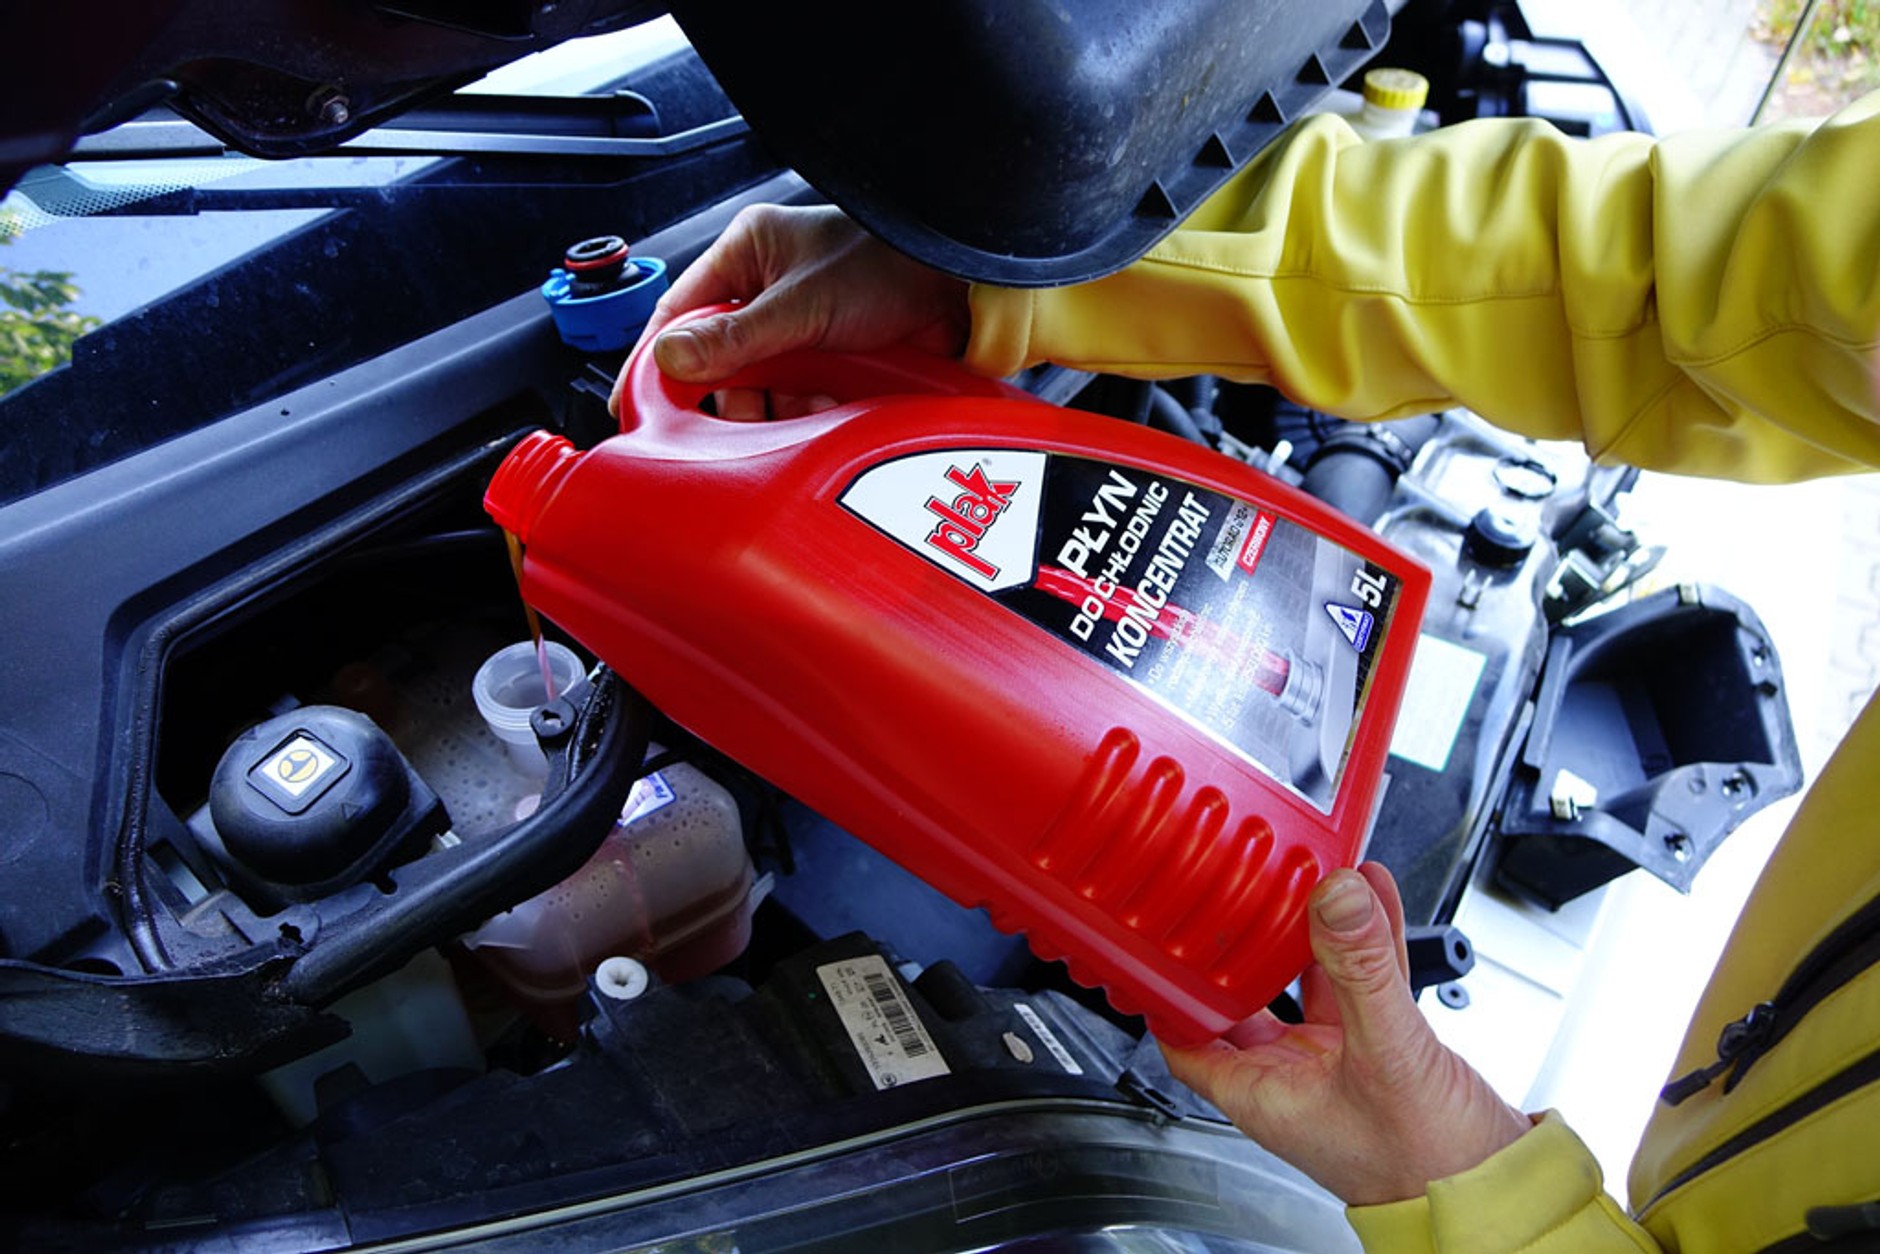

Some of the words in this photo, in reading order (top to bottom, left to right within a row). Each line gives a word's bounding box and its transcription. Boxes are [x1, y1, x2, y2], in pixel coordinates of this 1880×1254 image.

[924, 462, 1021, 581] plak
[1057, 469, 1138, 579] PŁYN
[1069, 595, 1104, 641] DO
[1094, 481, 1169, 599] CHŁODNIC
[1105, 491, 1211, 668] KONCENTRAT
[1351, 568, 1387, 608] 5L
